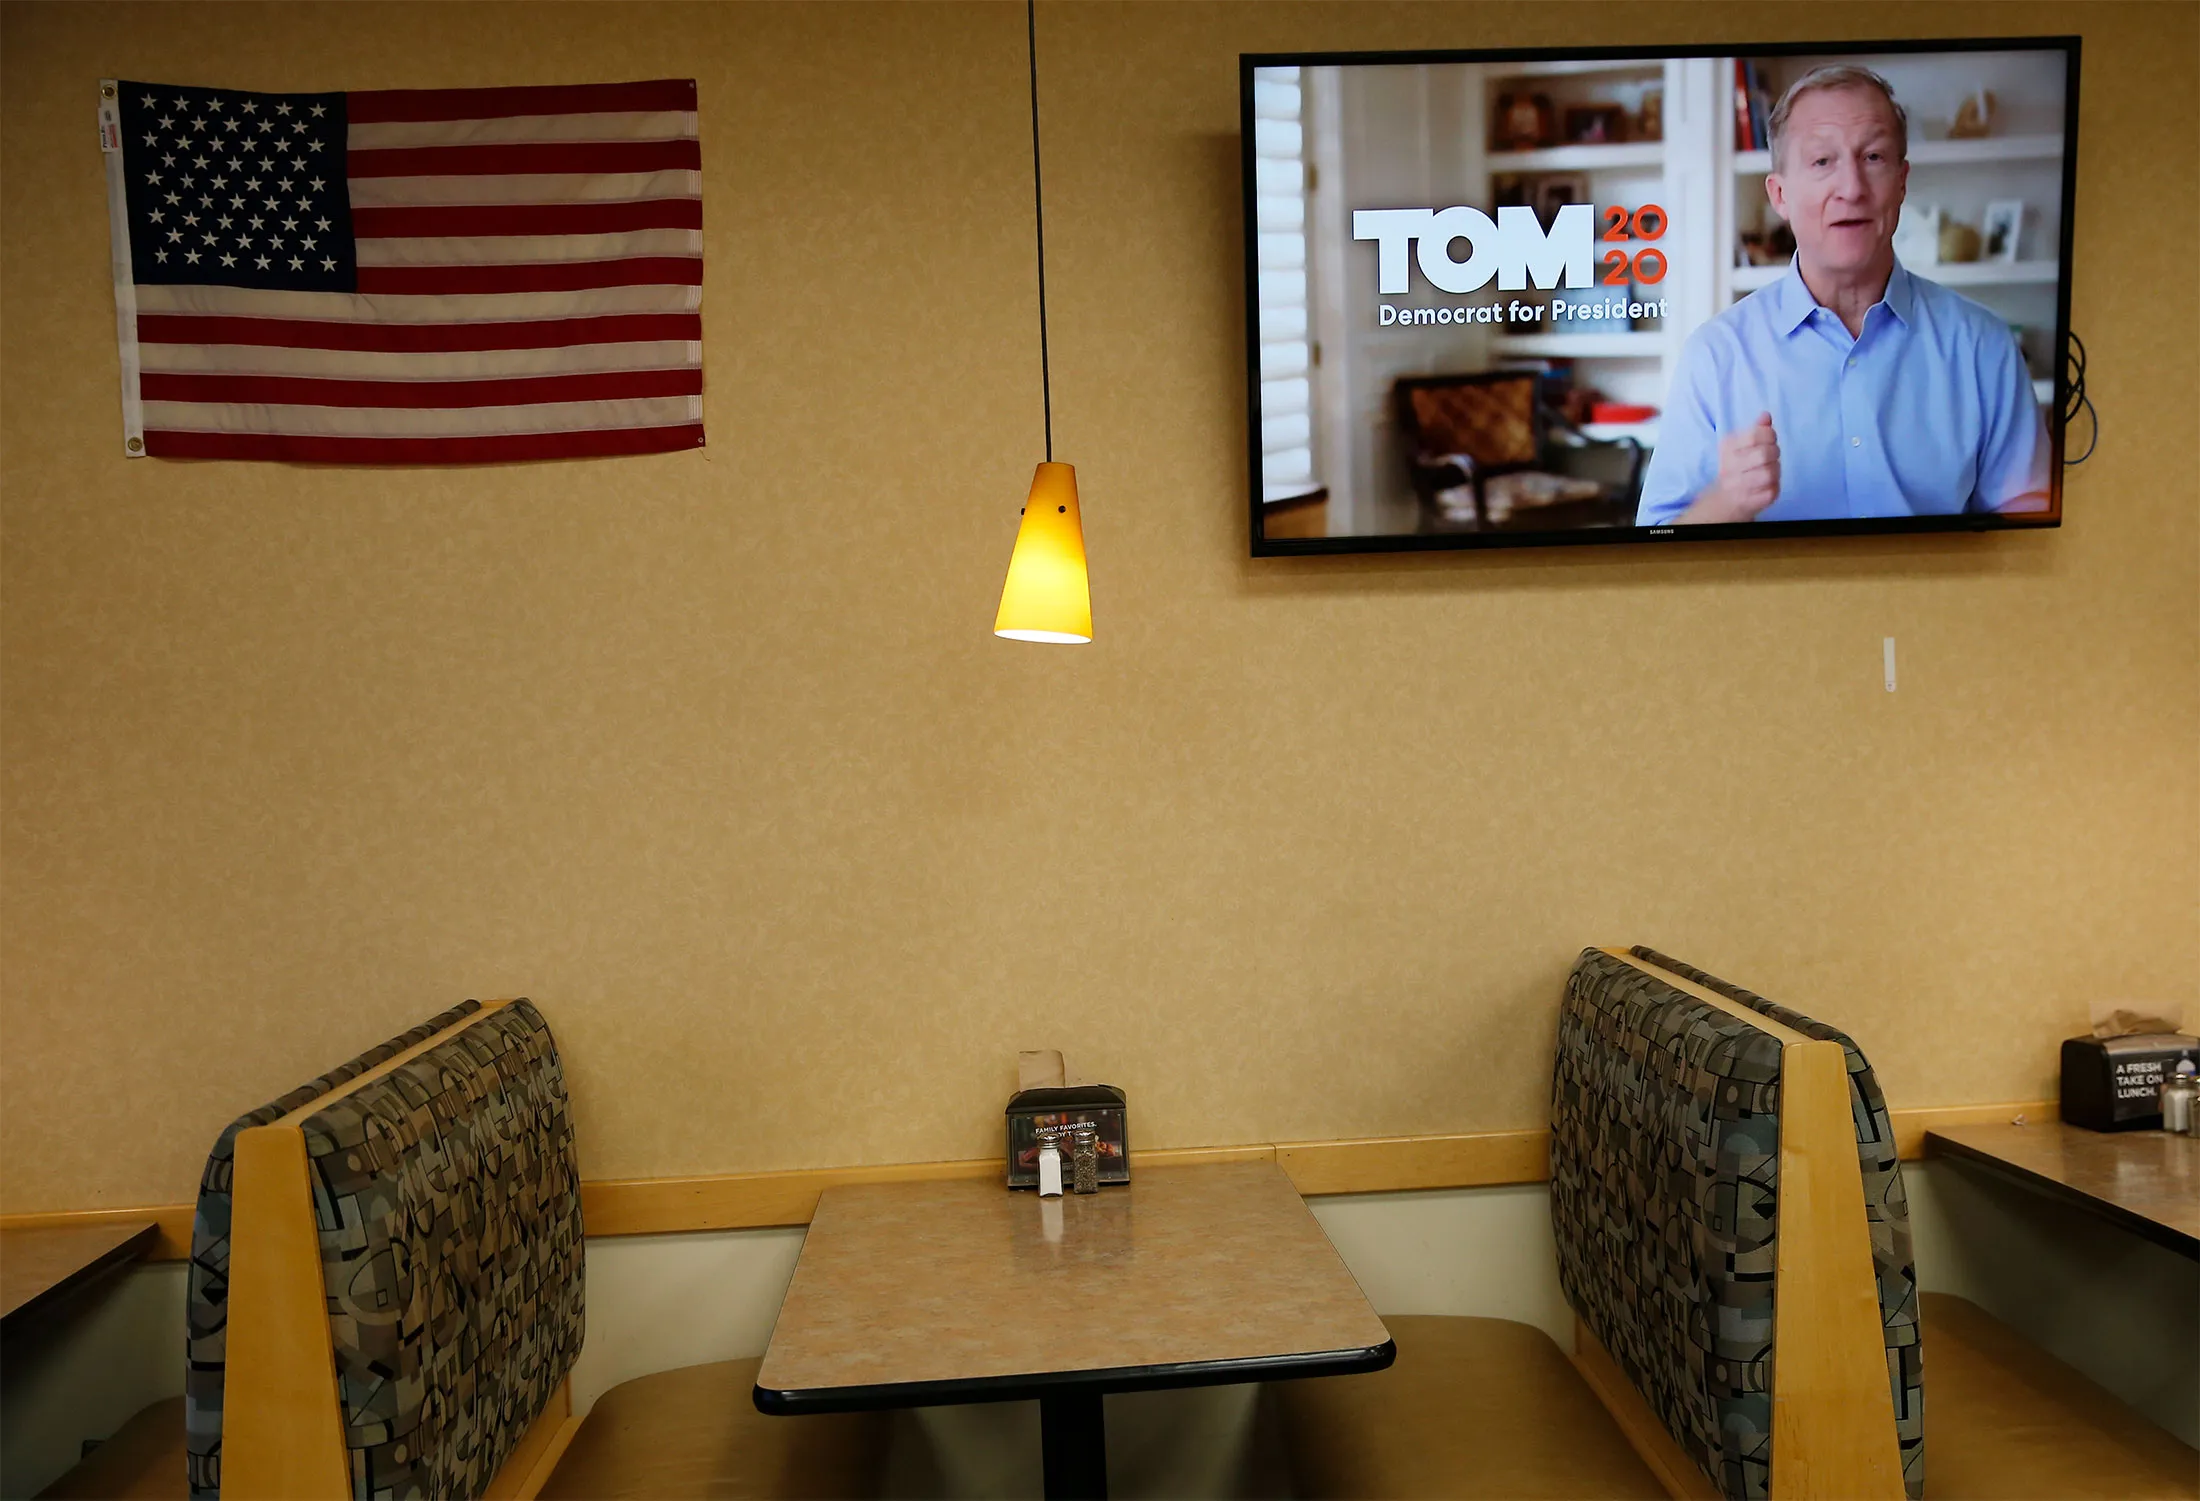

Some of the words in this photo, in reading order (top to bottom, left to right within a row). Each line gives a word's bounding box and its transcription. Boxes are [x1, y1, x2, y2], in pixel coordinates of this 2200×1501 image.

[1603, 204, 1668, 242] 20
[1352, 204, 1595, 295] TOM
[1603, 248, 1668, 286] 20
[1379, 302, 1503, 326] Democrat
[1508, 300, 1545, 322] for
[1551, 297, 1668, 321] President
[2116, 1065, 2125, 1074] A
[2126, 1062, 2162, 1074] FRESH
[2116, 1075, 2145, 1086] TAKE
[2146, 1074, 2164, 1084] ON
[2117, 1087, 2158, 1099] LUNCH.
[1035, 1125, 1058, 1134] FAMILY
